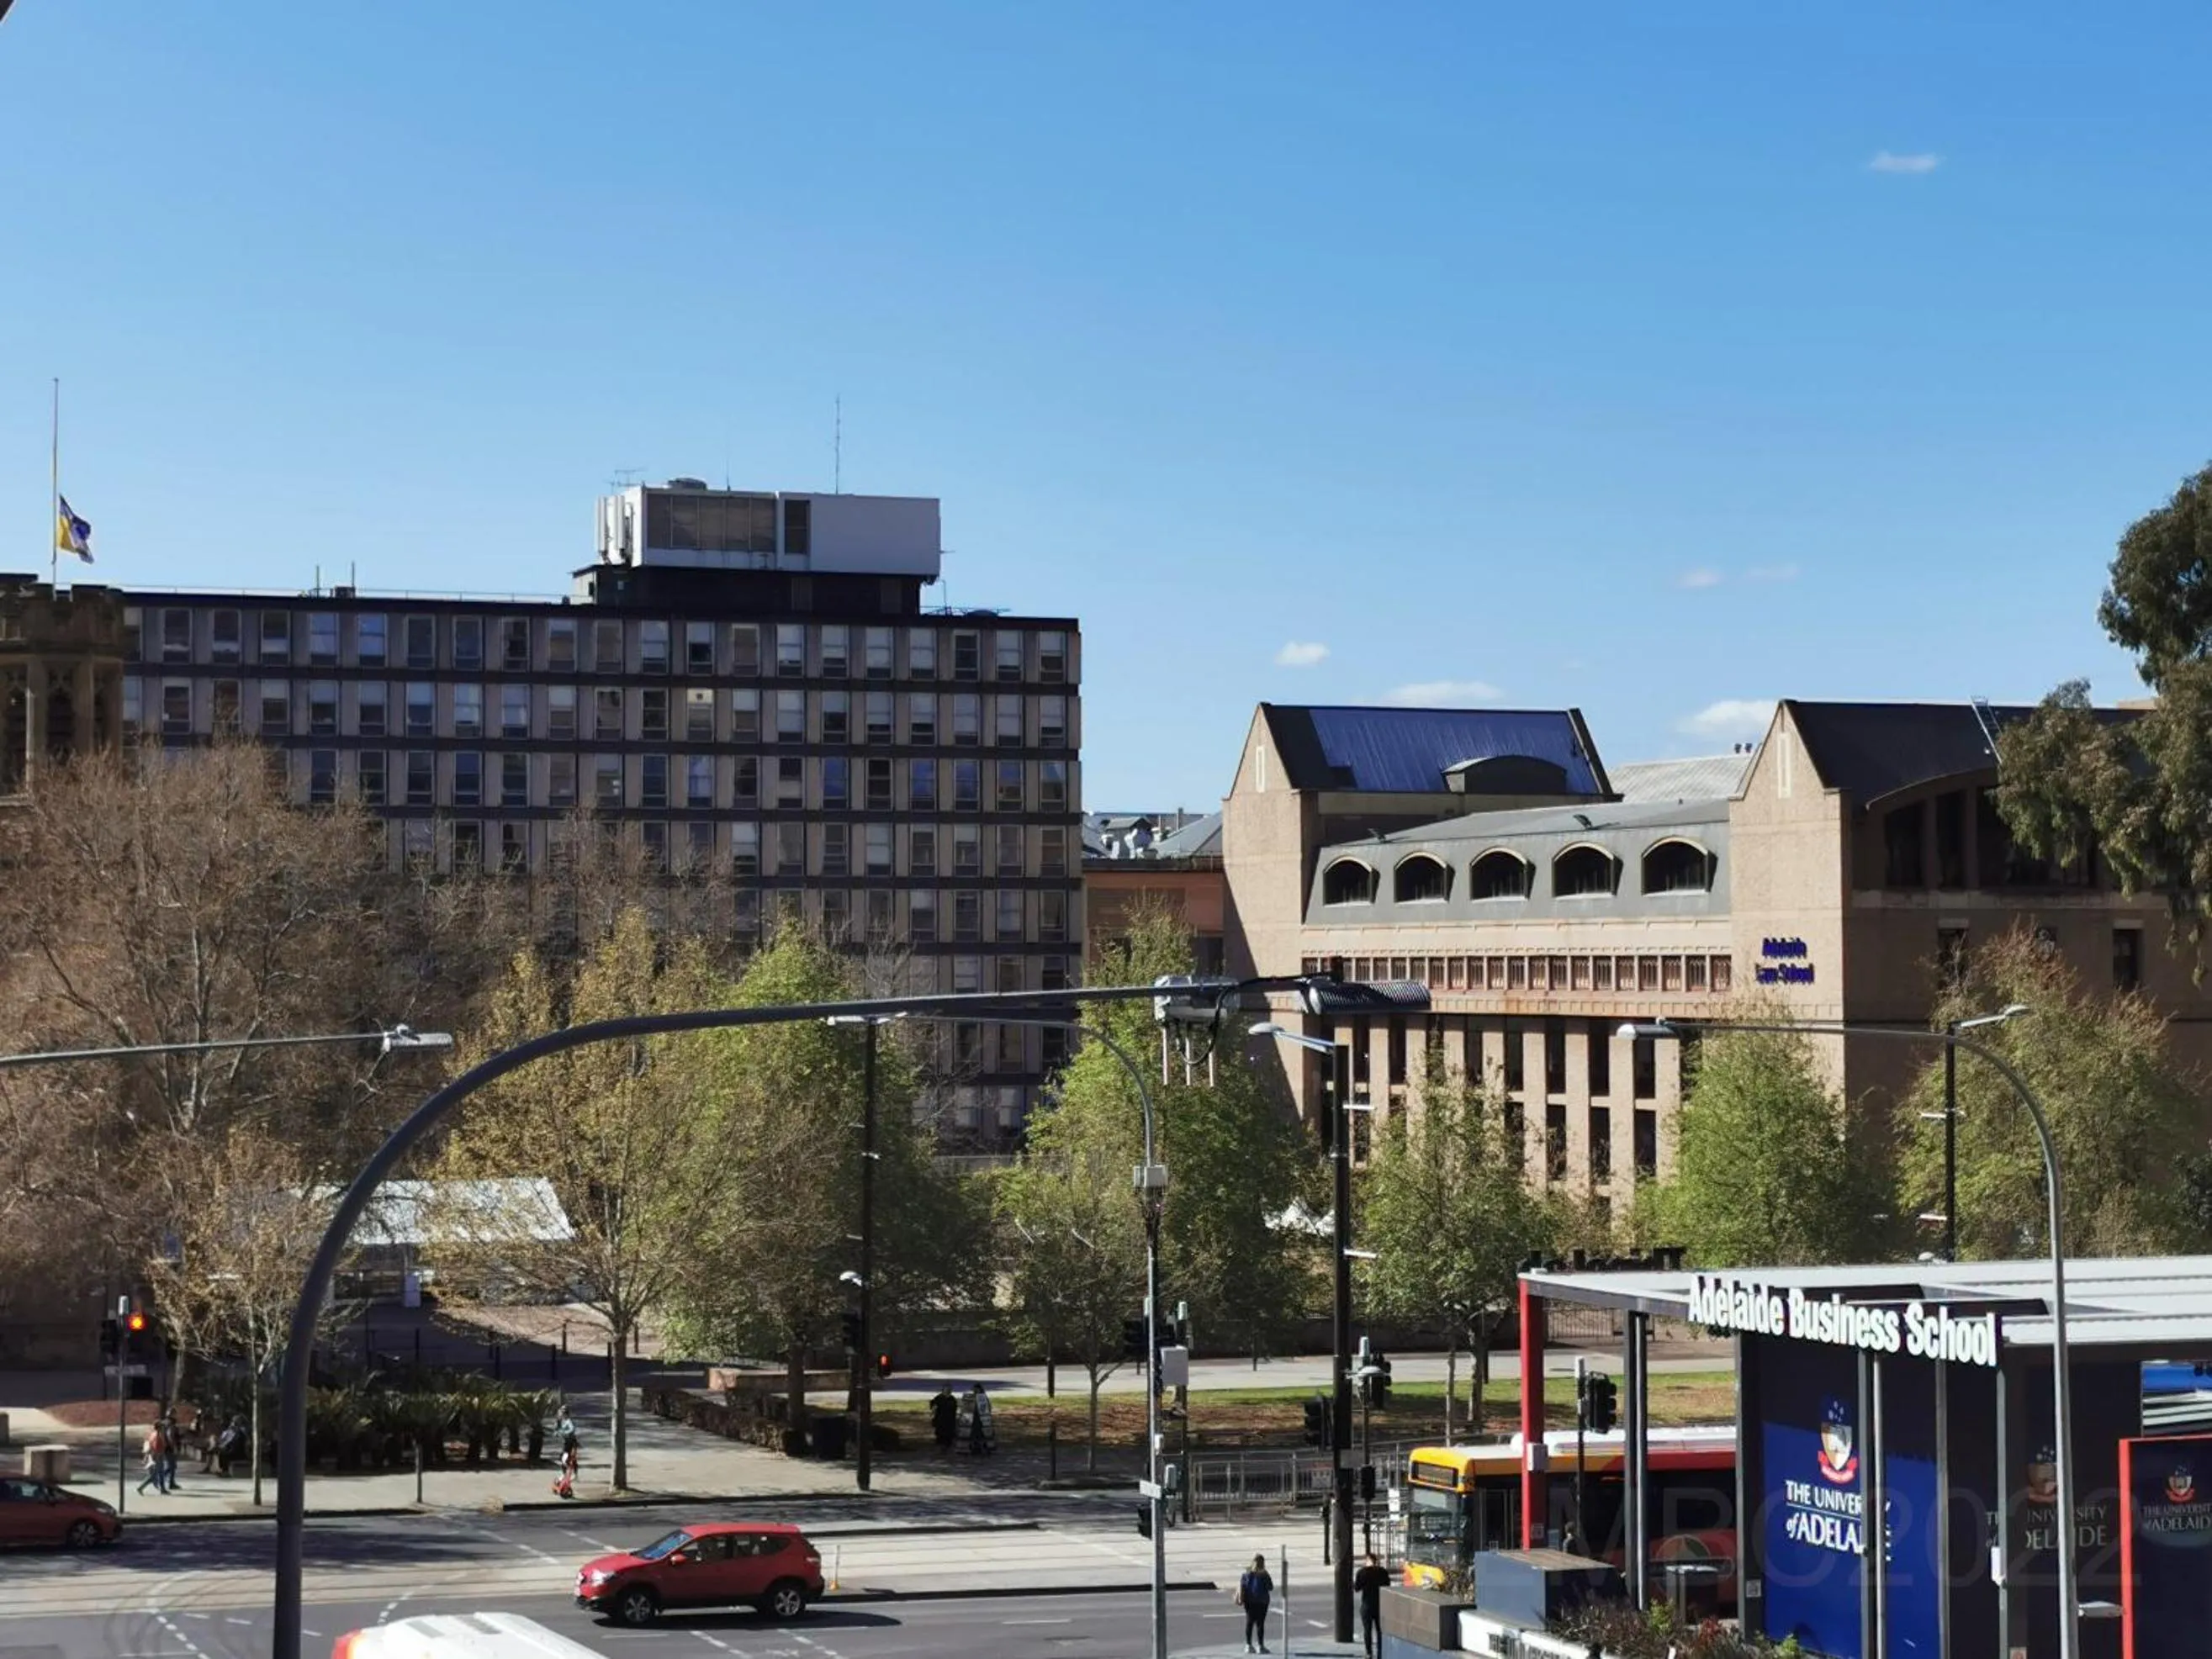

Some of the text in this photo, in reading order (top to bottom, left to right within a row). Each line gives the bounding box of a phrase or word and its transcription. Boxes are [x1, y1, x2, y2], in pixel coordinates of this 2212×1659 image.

[1688, 1274, 1997, 1366] Adelaide Business School
[1786, 1480, 1811, 1505] THE
